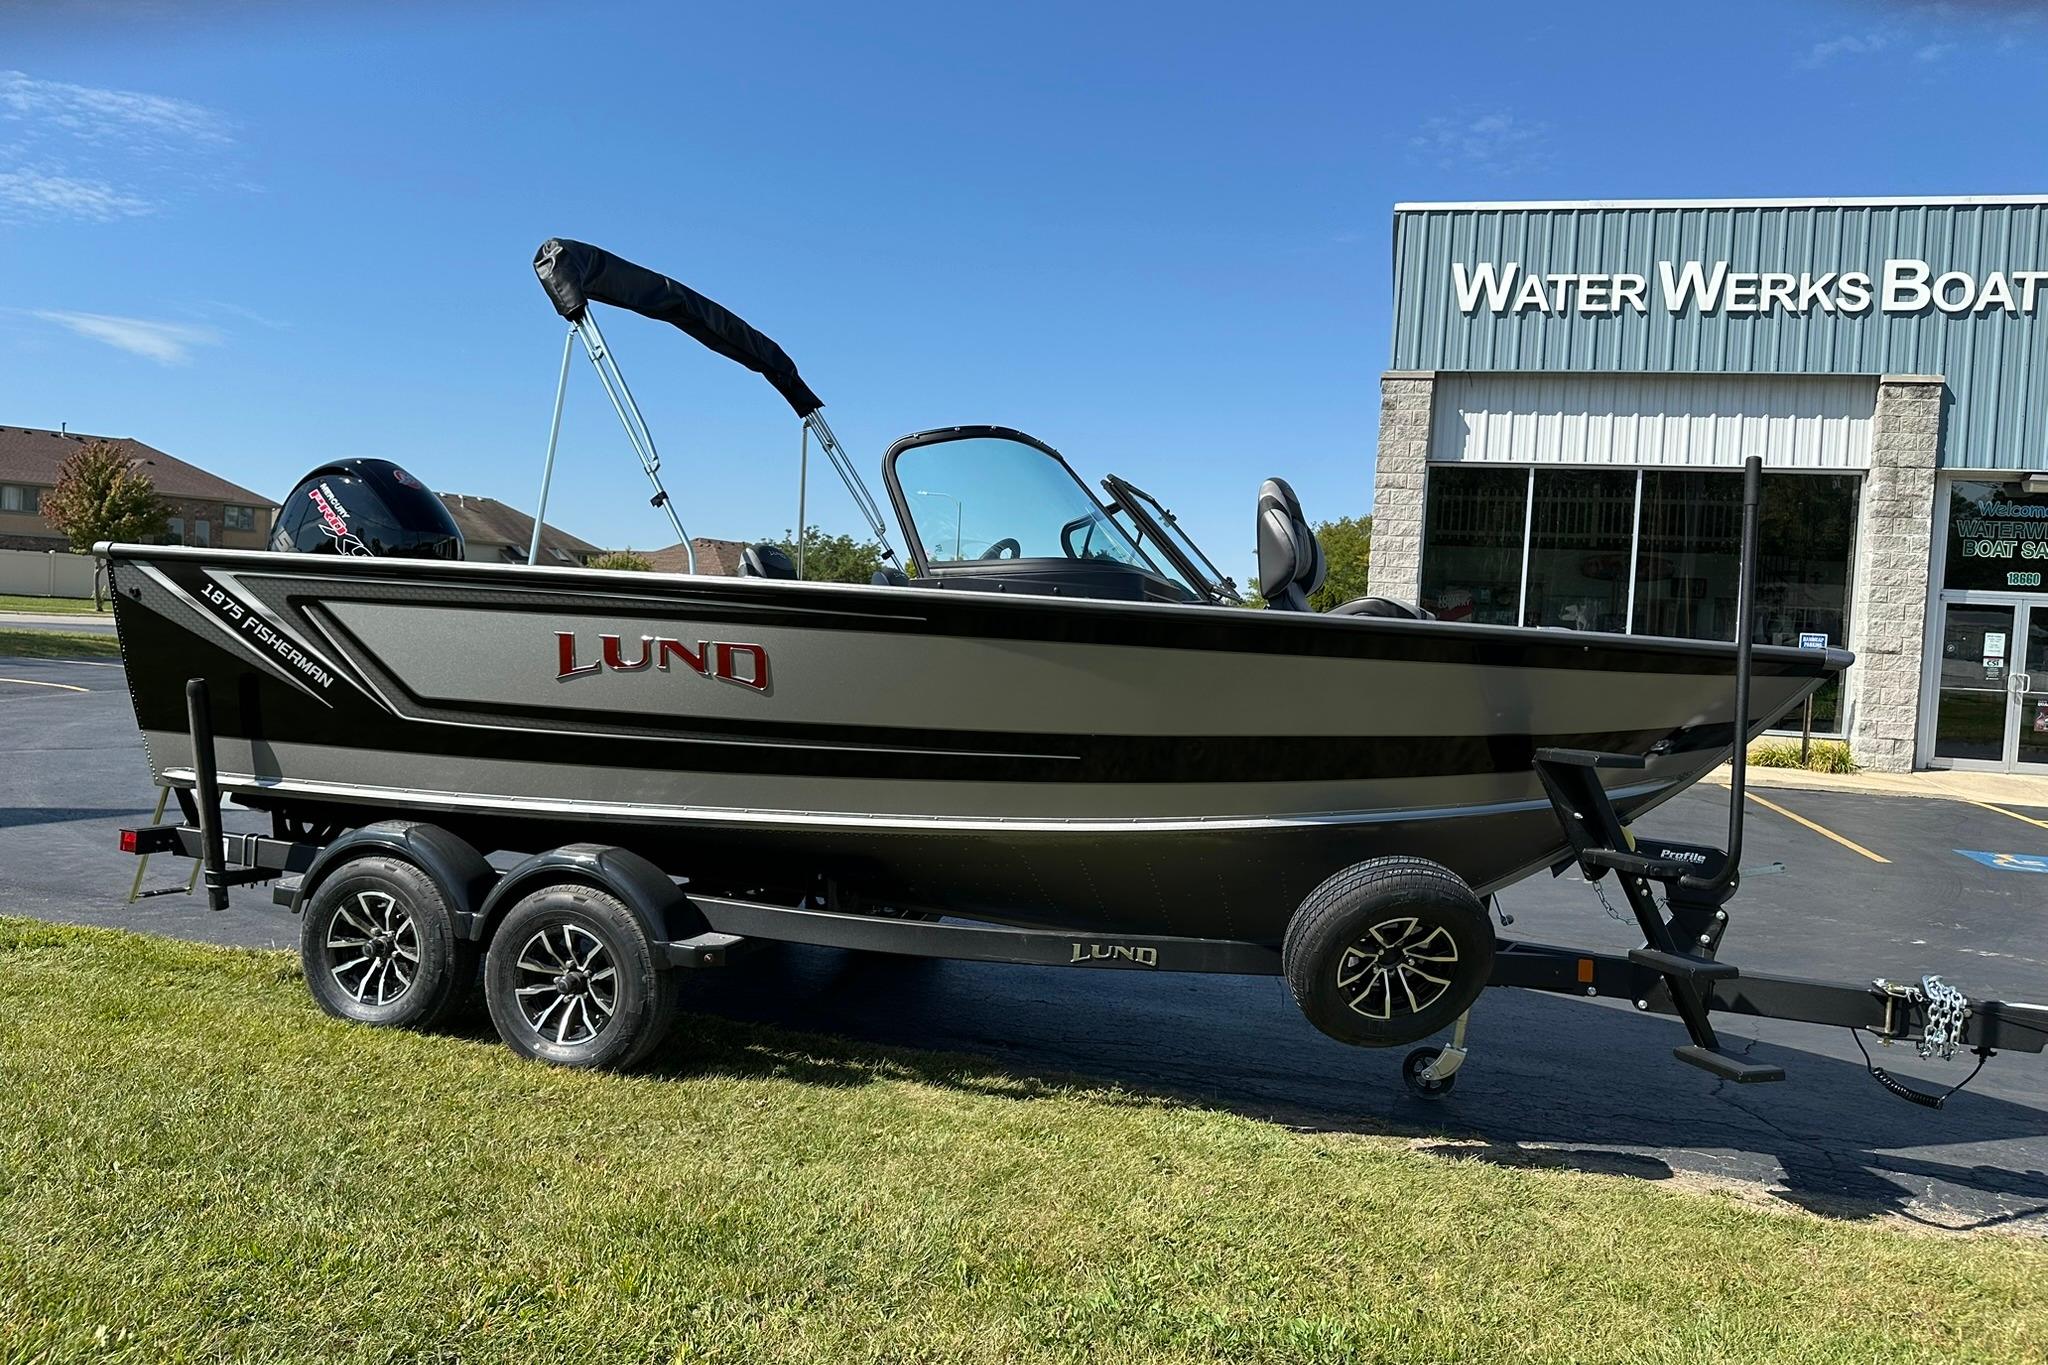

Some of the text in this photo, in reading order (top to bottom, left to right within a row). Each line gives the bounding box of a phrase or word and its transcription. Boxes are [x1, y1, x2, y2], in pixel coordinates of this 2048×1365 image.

[1452, 259, 2048, 312] WATER WERKS BOAT
[308, 488, 347, 536] PRO
[320, 482, 350, 518] MERCURY
[1963, 539, 2017, 558] BOAT
[2007, 572, 2041, 586] 18660
[201, 583, 334, 688] 1875 FISHERMAN
[554, 631, 769, 691] LUND
[1660, 849, 1706, 861] Profile
[1070, 943, 1157, 967] LUND
